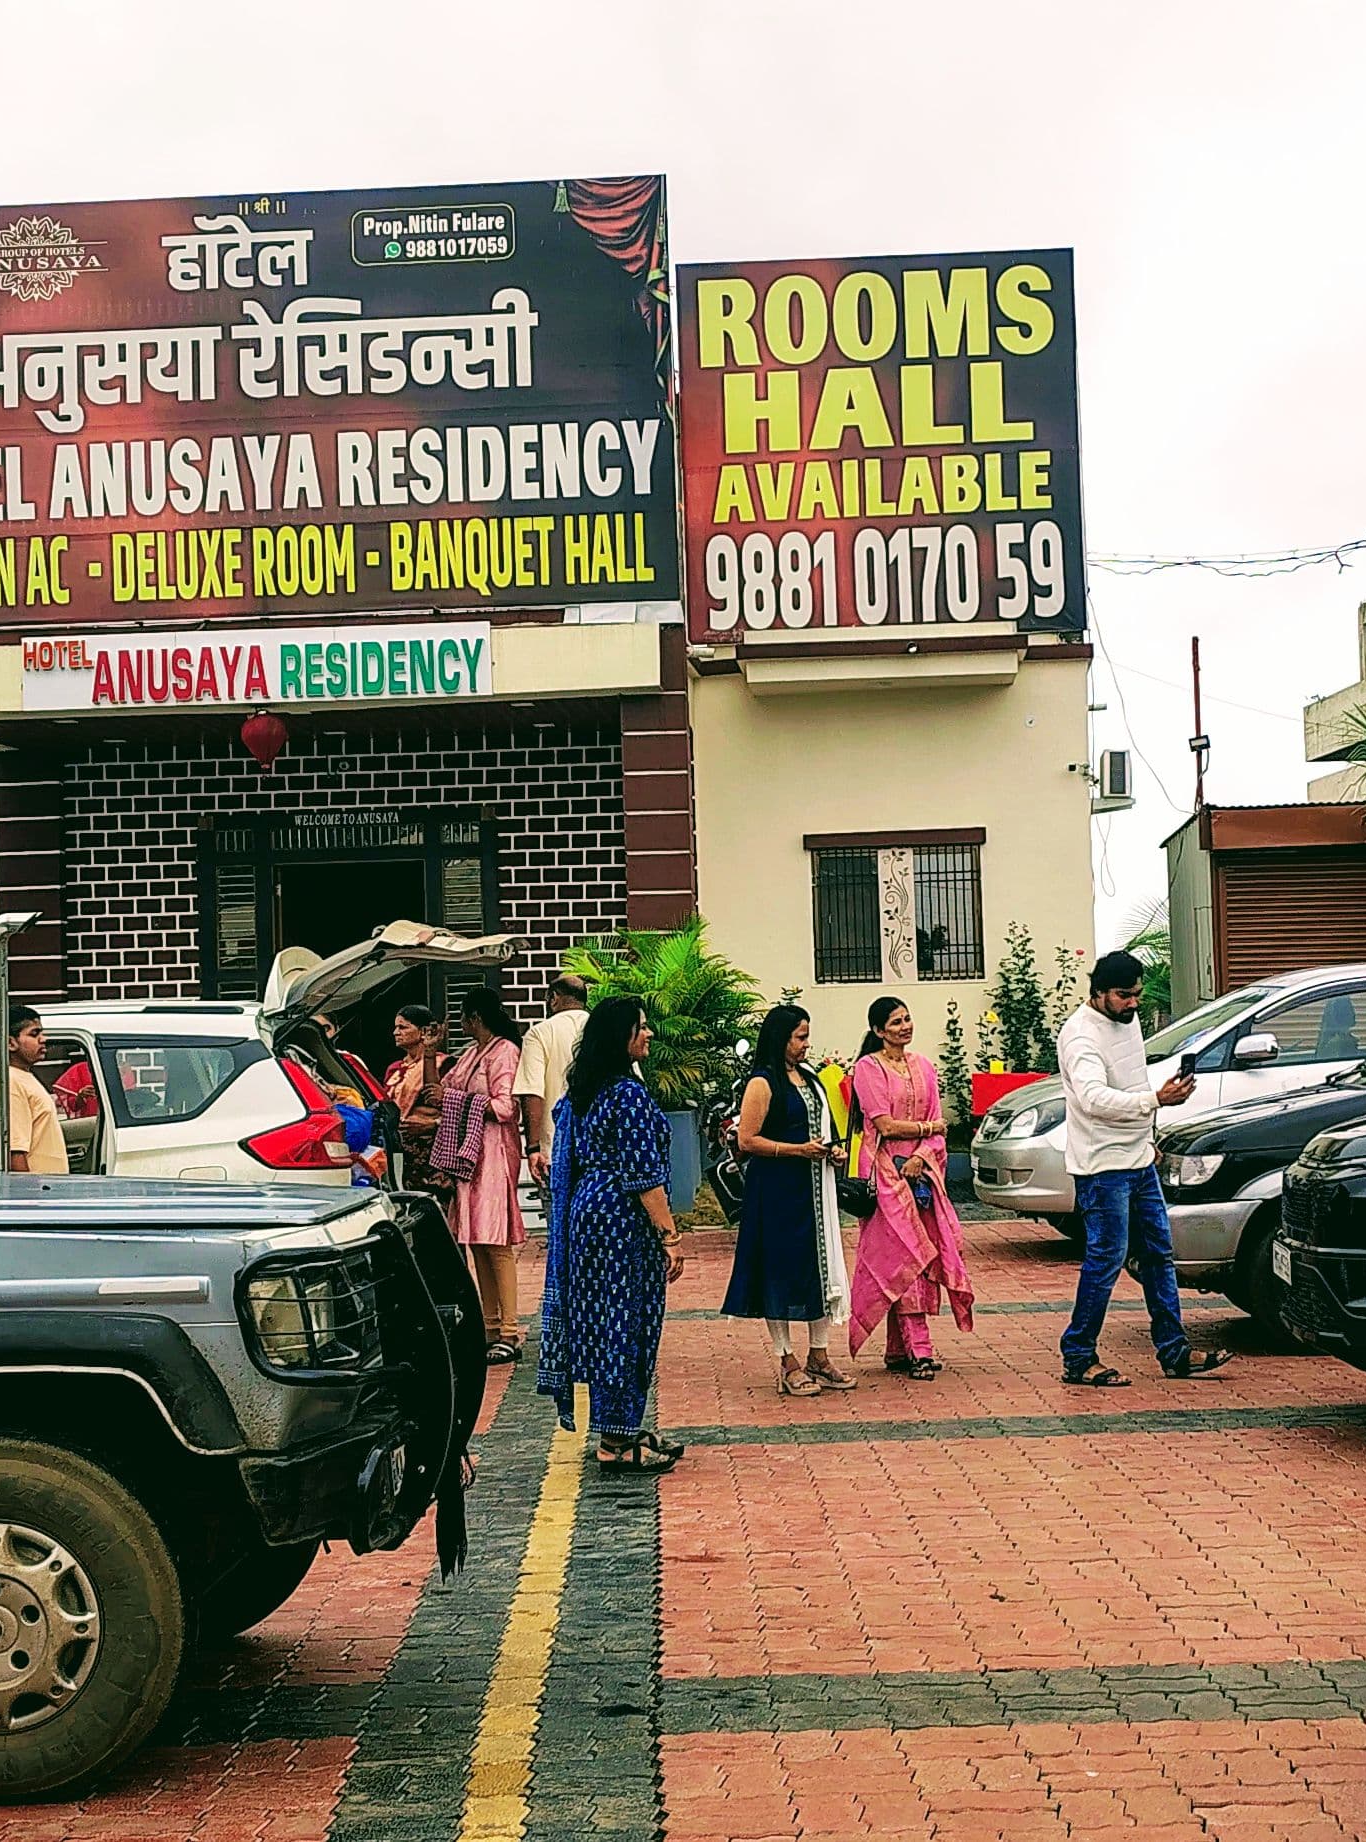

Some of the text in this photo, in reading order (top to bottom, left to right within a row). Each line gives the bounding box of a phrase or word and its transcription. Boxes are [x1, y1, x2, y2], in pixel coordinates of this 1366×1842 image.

[30, 248, 44, 256] OF
[45, 246, 85, 256] HOTELS
[161, 214, 313, 292] हॉटेल
[405, 236, 508, 258] 9881017059
[452, 213, 505, 231] Fulare
[231, 288, 539, 398] रेसिडन्सी
[697, 264, 1055, 368] ROOMS
[723, 361, 1035, 454] HALL
[48, 434, 323, 519] ANUSAYA
[339, 418, 661, 507] RESIDENCY
[713, 450, 1053, 524] AVAILABLE
[26, 535, 70, 607] AC
[112, 528, 243, 602] DELUXE
[253, 523, 357, 596] ROOM
[390, 515, 556, 596] BANQUET
[566, 511, 656, 584] HALL
[705, 520, 1066, 631] 9881 0170 59
[23, 637, 485, 704] HOTEL ANUSAYA RESIDENCY
[295, 812, 399, 826] WELCOME TO ANUSAYA
